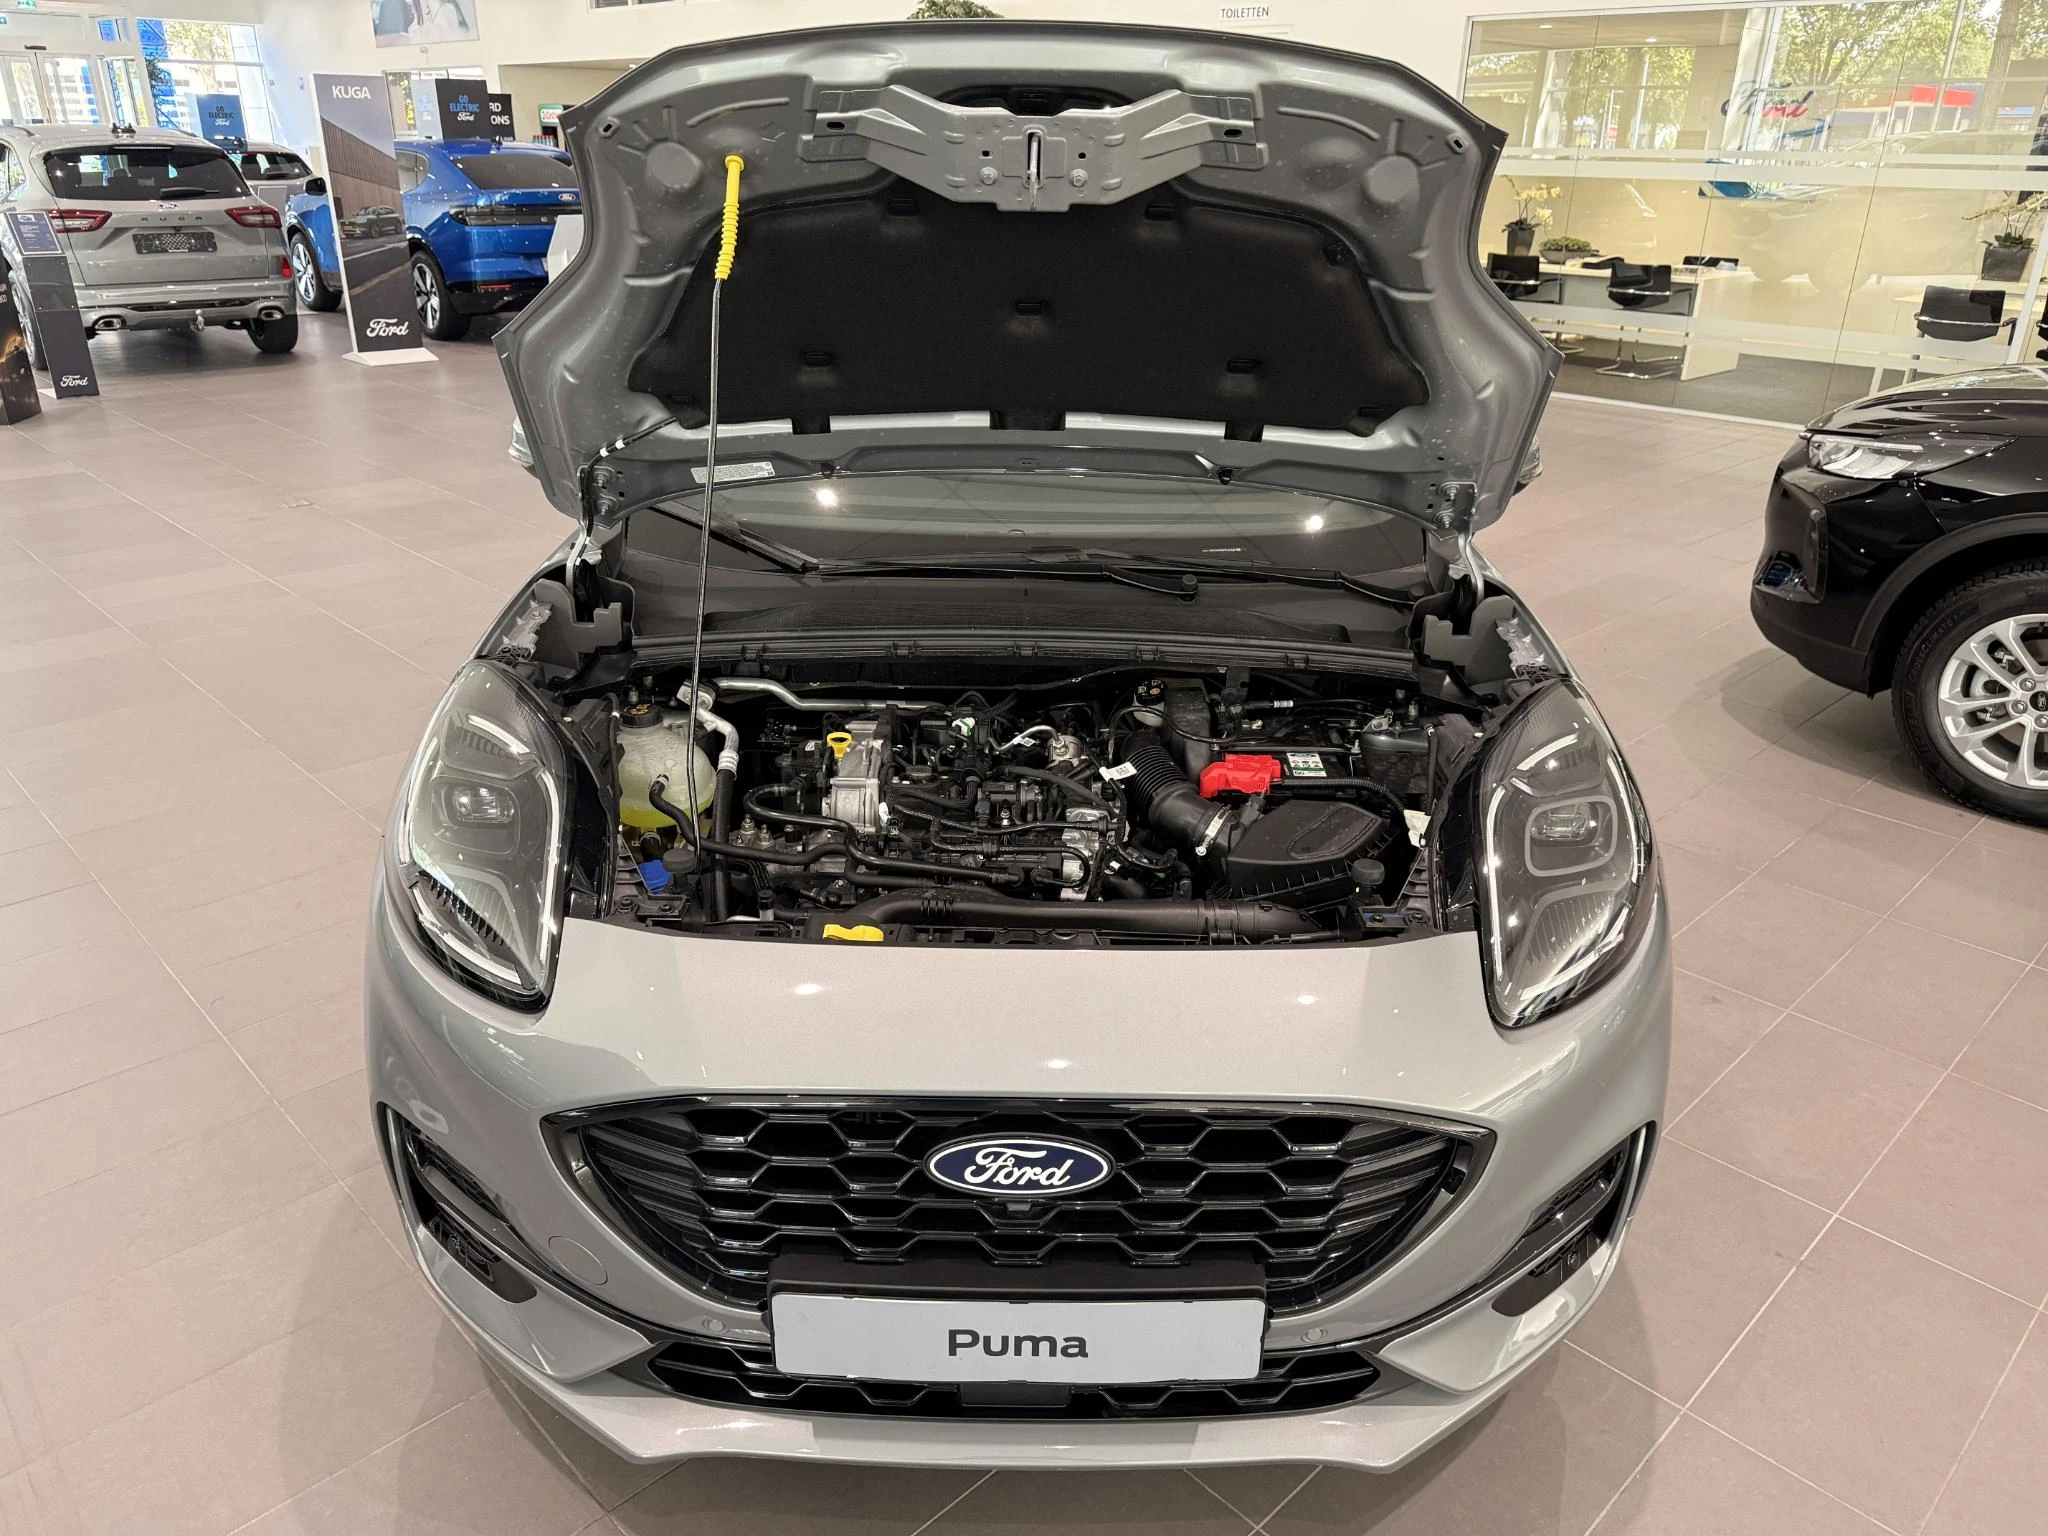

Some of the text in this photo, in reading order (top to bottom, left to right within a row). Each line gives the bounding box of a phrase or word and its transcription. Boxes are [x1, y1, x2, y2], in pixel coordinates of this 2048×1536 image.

[1220, 6, 1270, 19] TOILETTEN
[332, 85, 371, 99] KUGA
[458, 94, 469, 104] GO
[449, 103, 480, 112] ELECTRIC
[456, 112, 475, 121] Ford
[366, 318, 409, 338] Ford
[60, 374, 89, 387] Ford
[964, 1147, 1075, 1186] Ford
[948, 1329, 1089, 1358] Puma
